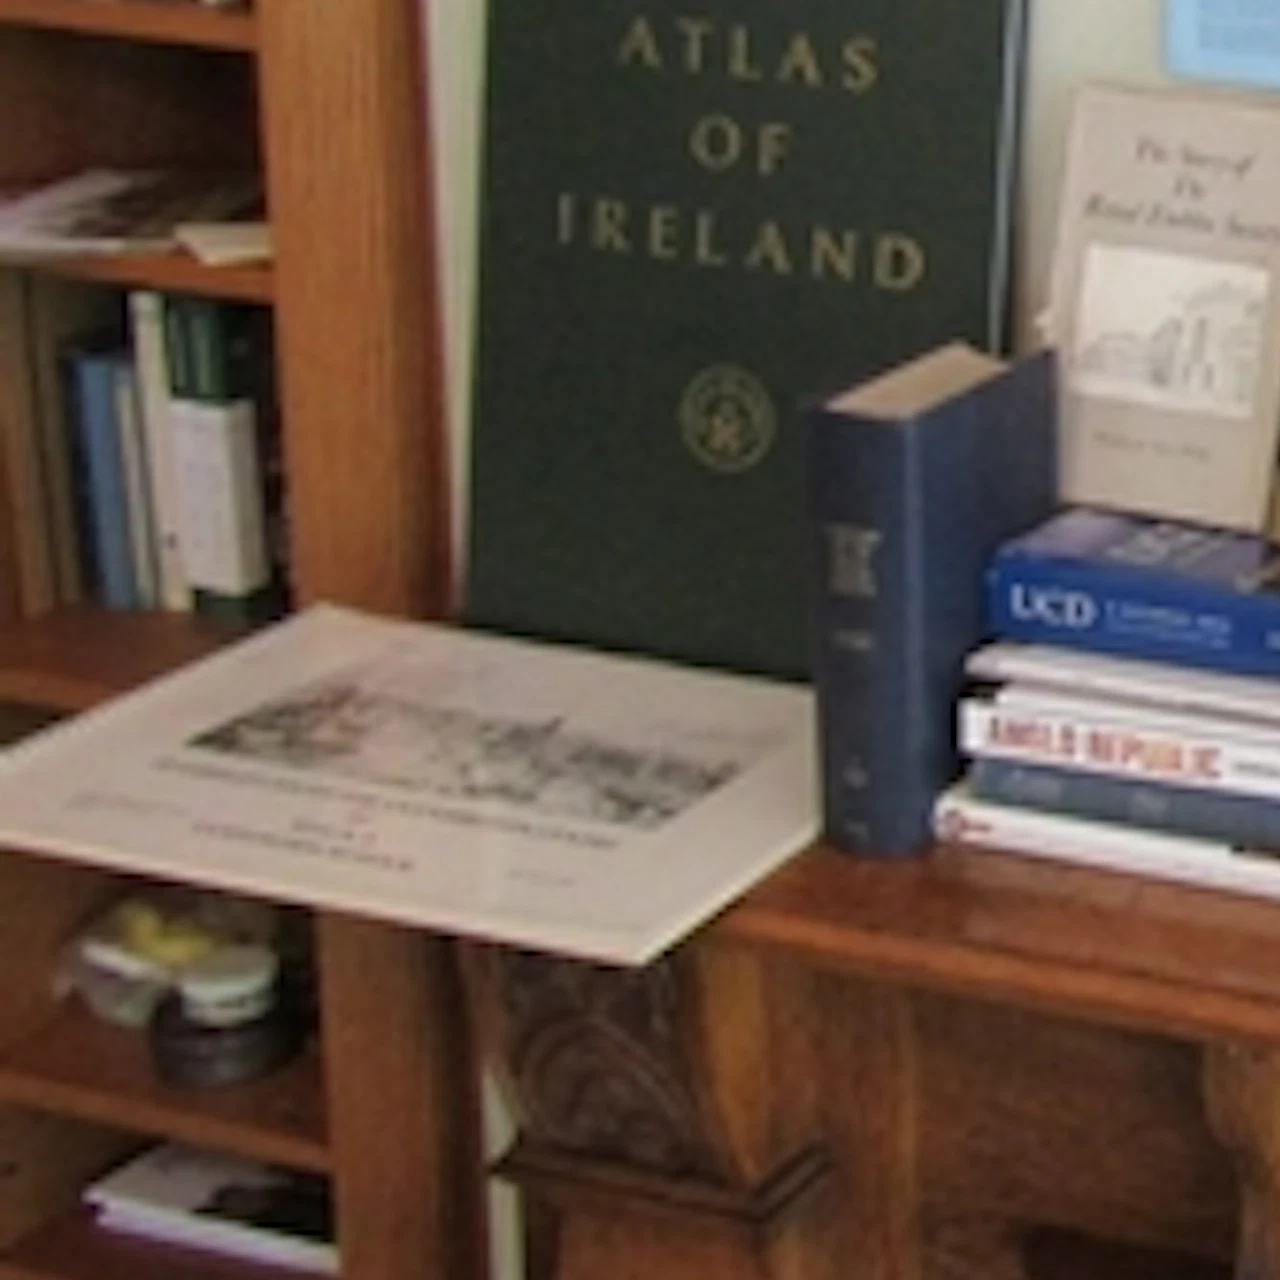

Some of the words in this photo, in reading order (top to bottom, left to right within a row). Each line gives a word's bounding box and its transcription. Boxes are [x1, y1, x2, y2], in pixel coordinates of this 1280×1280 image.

[618, 14, 882, 94] ATLAS
[688, 114, 795, 176] OF
[556, 192, 927, 291] IRELAND
[1010, 581, 1096, 630] UCD
